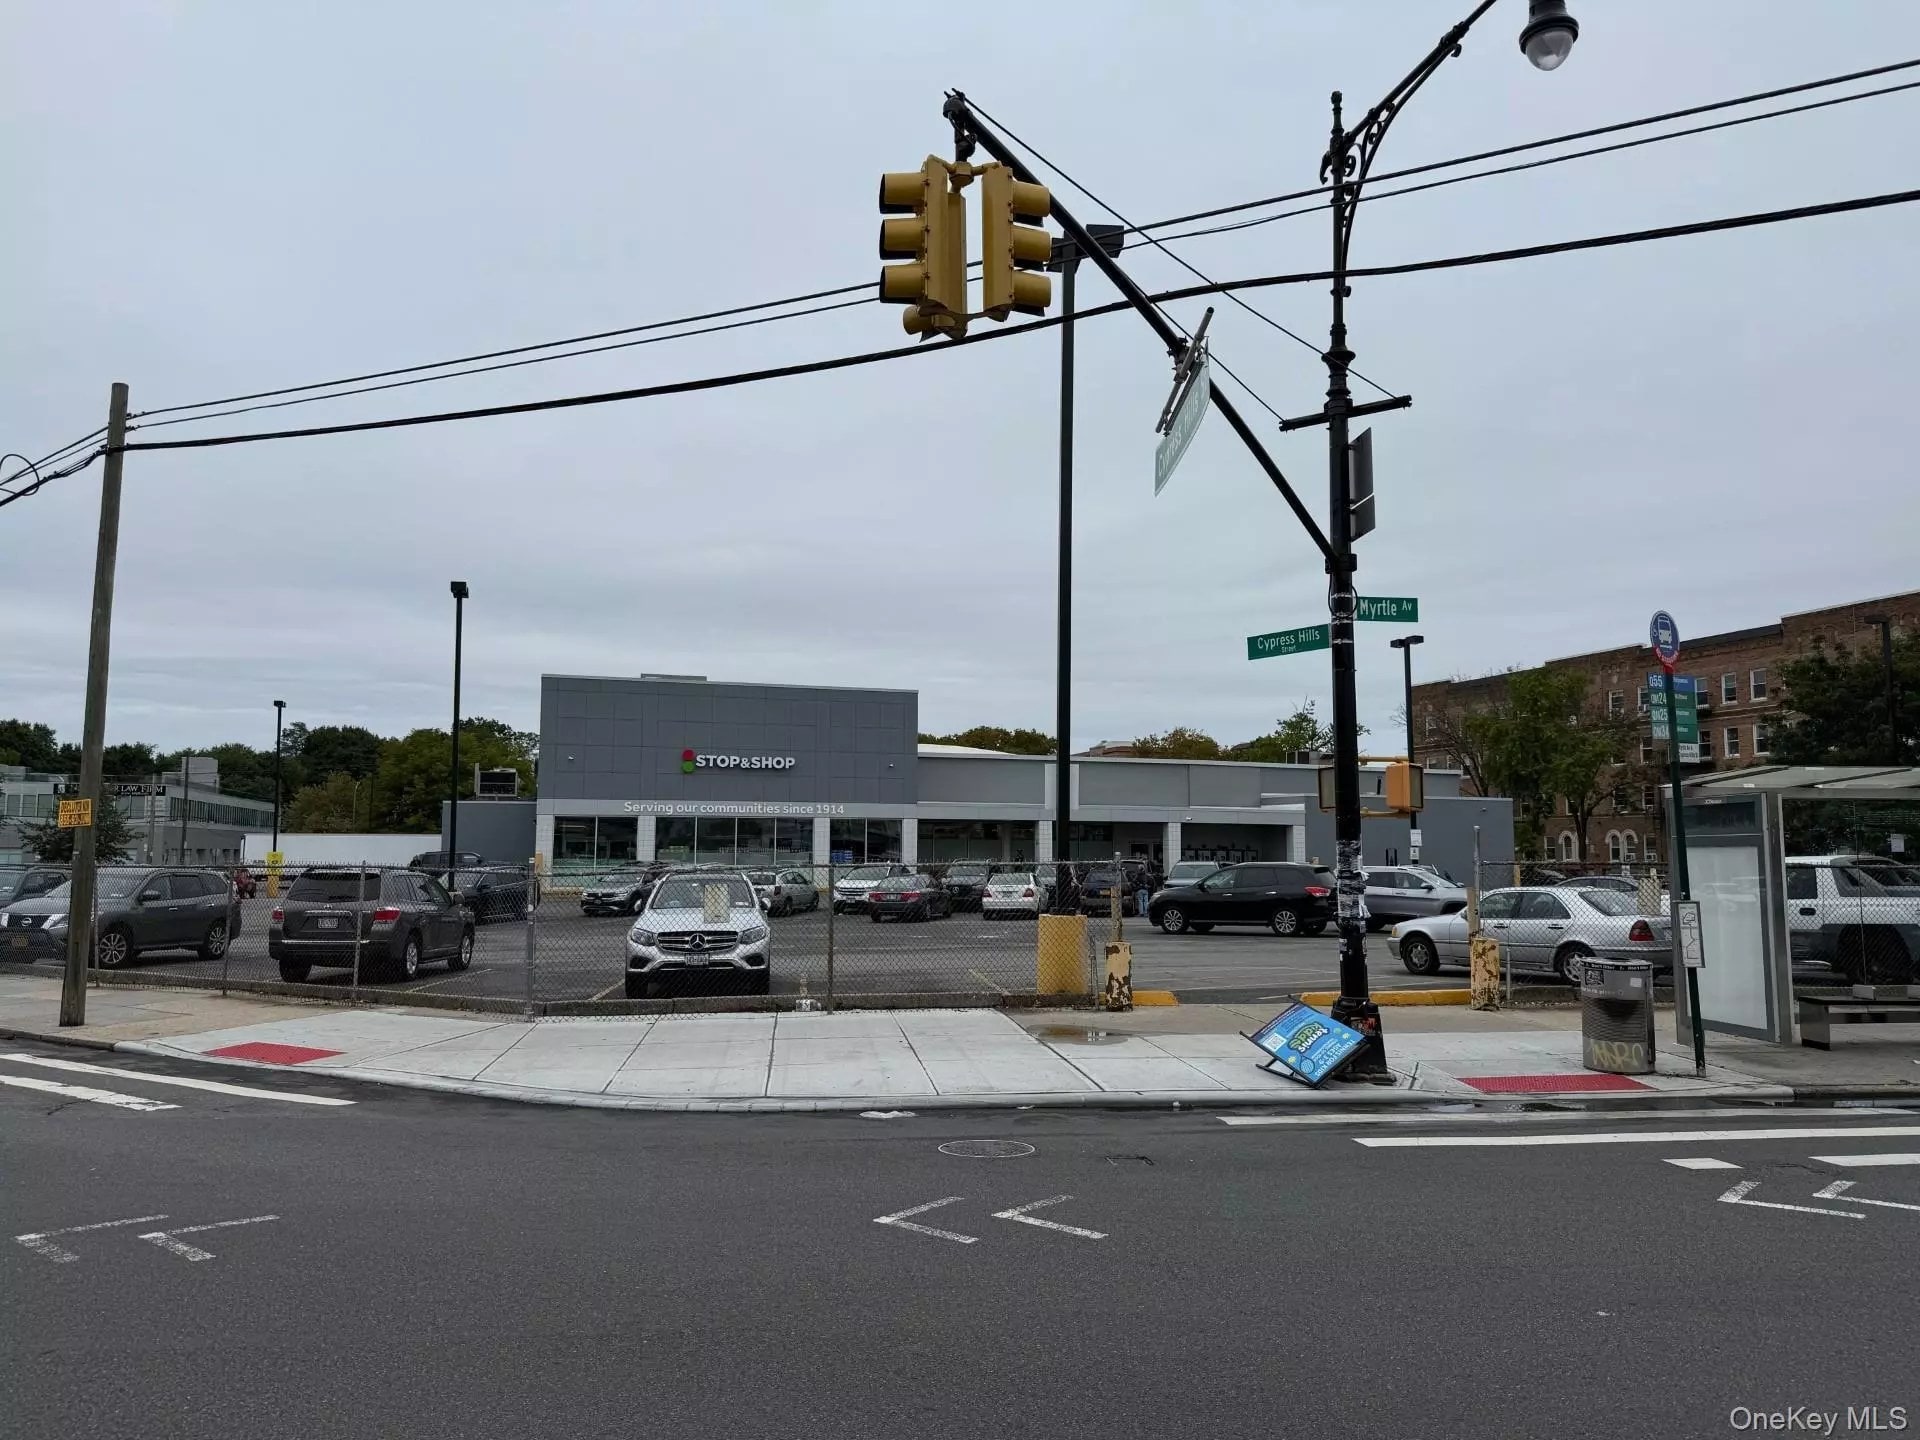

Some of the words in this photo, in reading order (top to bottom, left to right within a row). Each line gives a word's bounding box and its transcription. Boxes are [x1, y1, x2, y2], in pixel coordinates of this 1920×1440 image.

[1359, 600, 1397, 619] Myrtle
[1402, 601, 1412, 611] Av
[1257, 635, 1296, 651] Cypress
[1298, 628, 1320, 642] Hills
[695, 754, 796, 769] STOP&SHOP
[624, 802, 674, 815] Serving
[676, 804, 698, 813] our
[700, 802, 780, 814] communities
[783, 803, 814, 814] since
[816, 804, 845, 815] 1914
[1298, 1028, 1329, 1053] tennis
